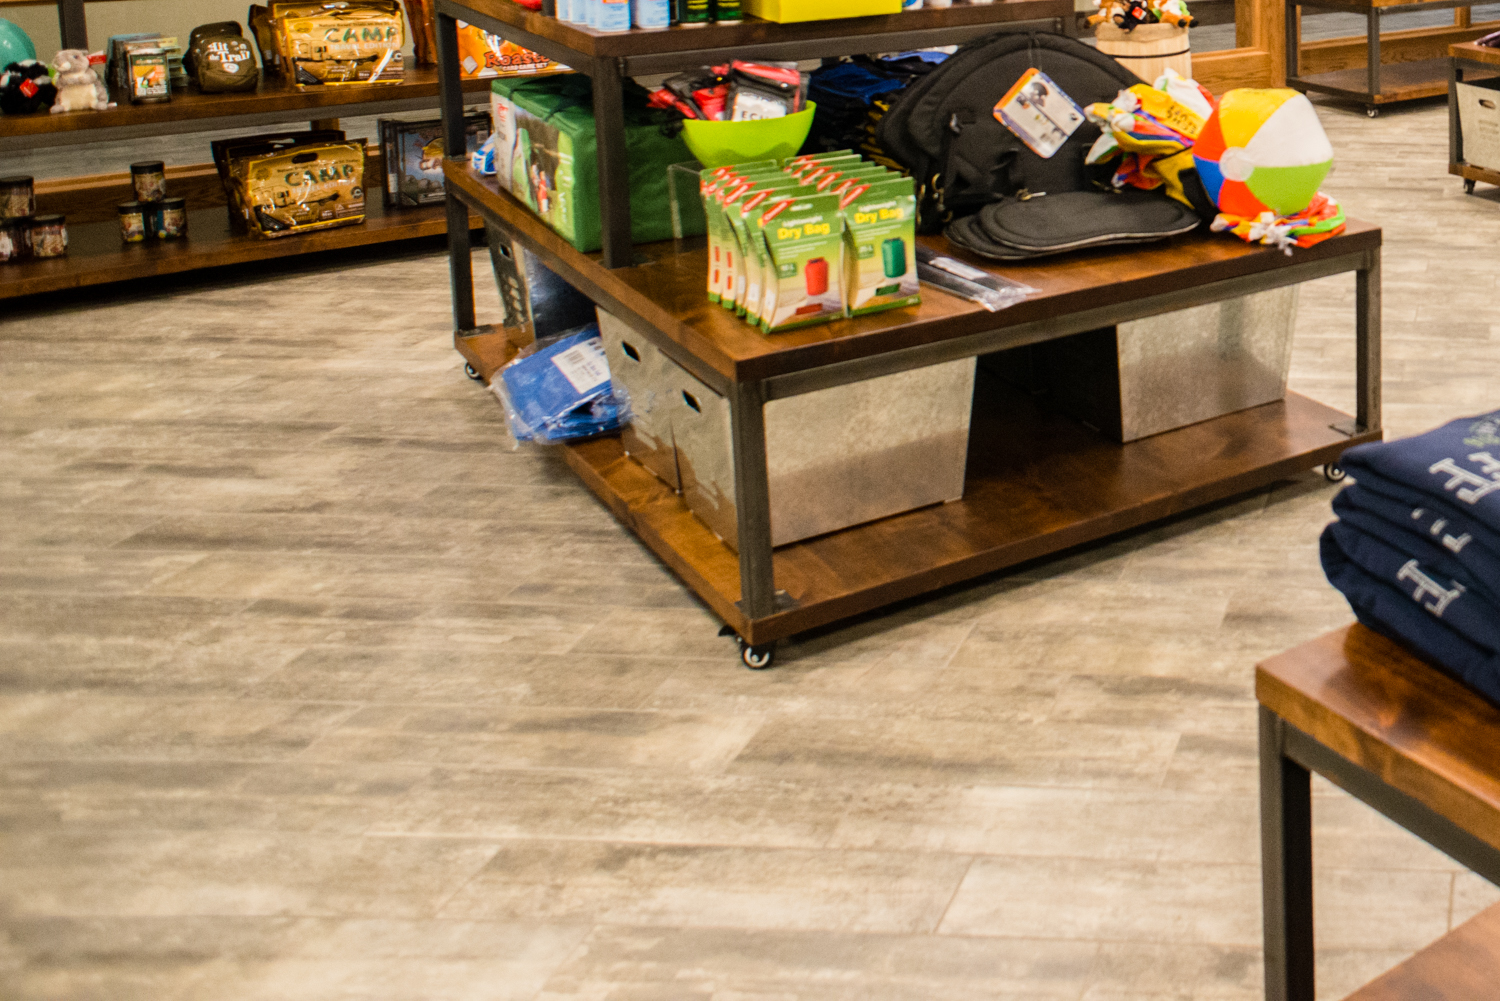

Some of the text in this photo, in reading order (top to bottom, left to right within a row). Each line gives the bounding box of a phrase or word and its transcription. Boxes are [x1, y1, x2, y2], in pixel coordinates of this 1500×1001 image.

[324, 26, 398, 42] CAMP
[221, 50, 250, 63] Trail
[284, 164, 355, 187] CAMP
[854, 207, 904, 224] Dry Bag
[777, 223, 831, 240] Dry Bag
